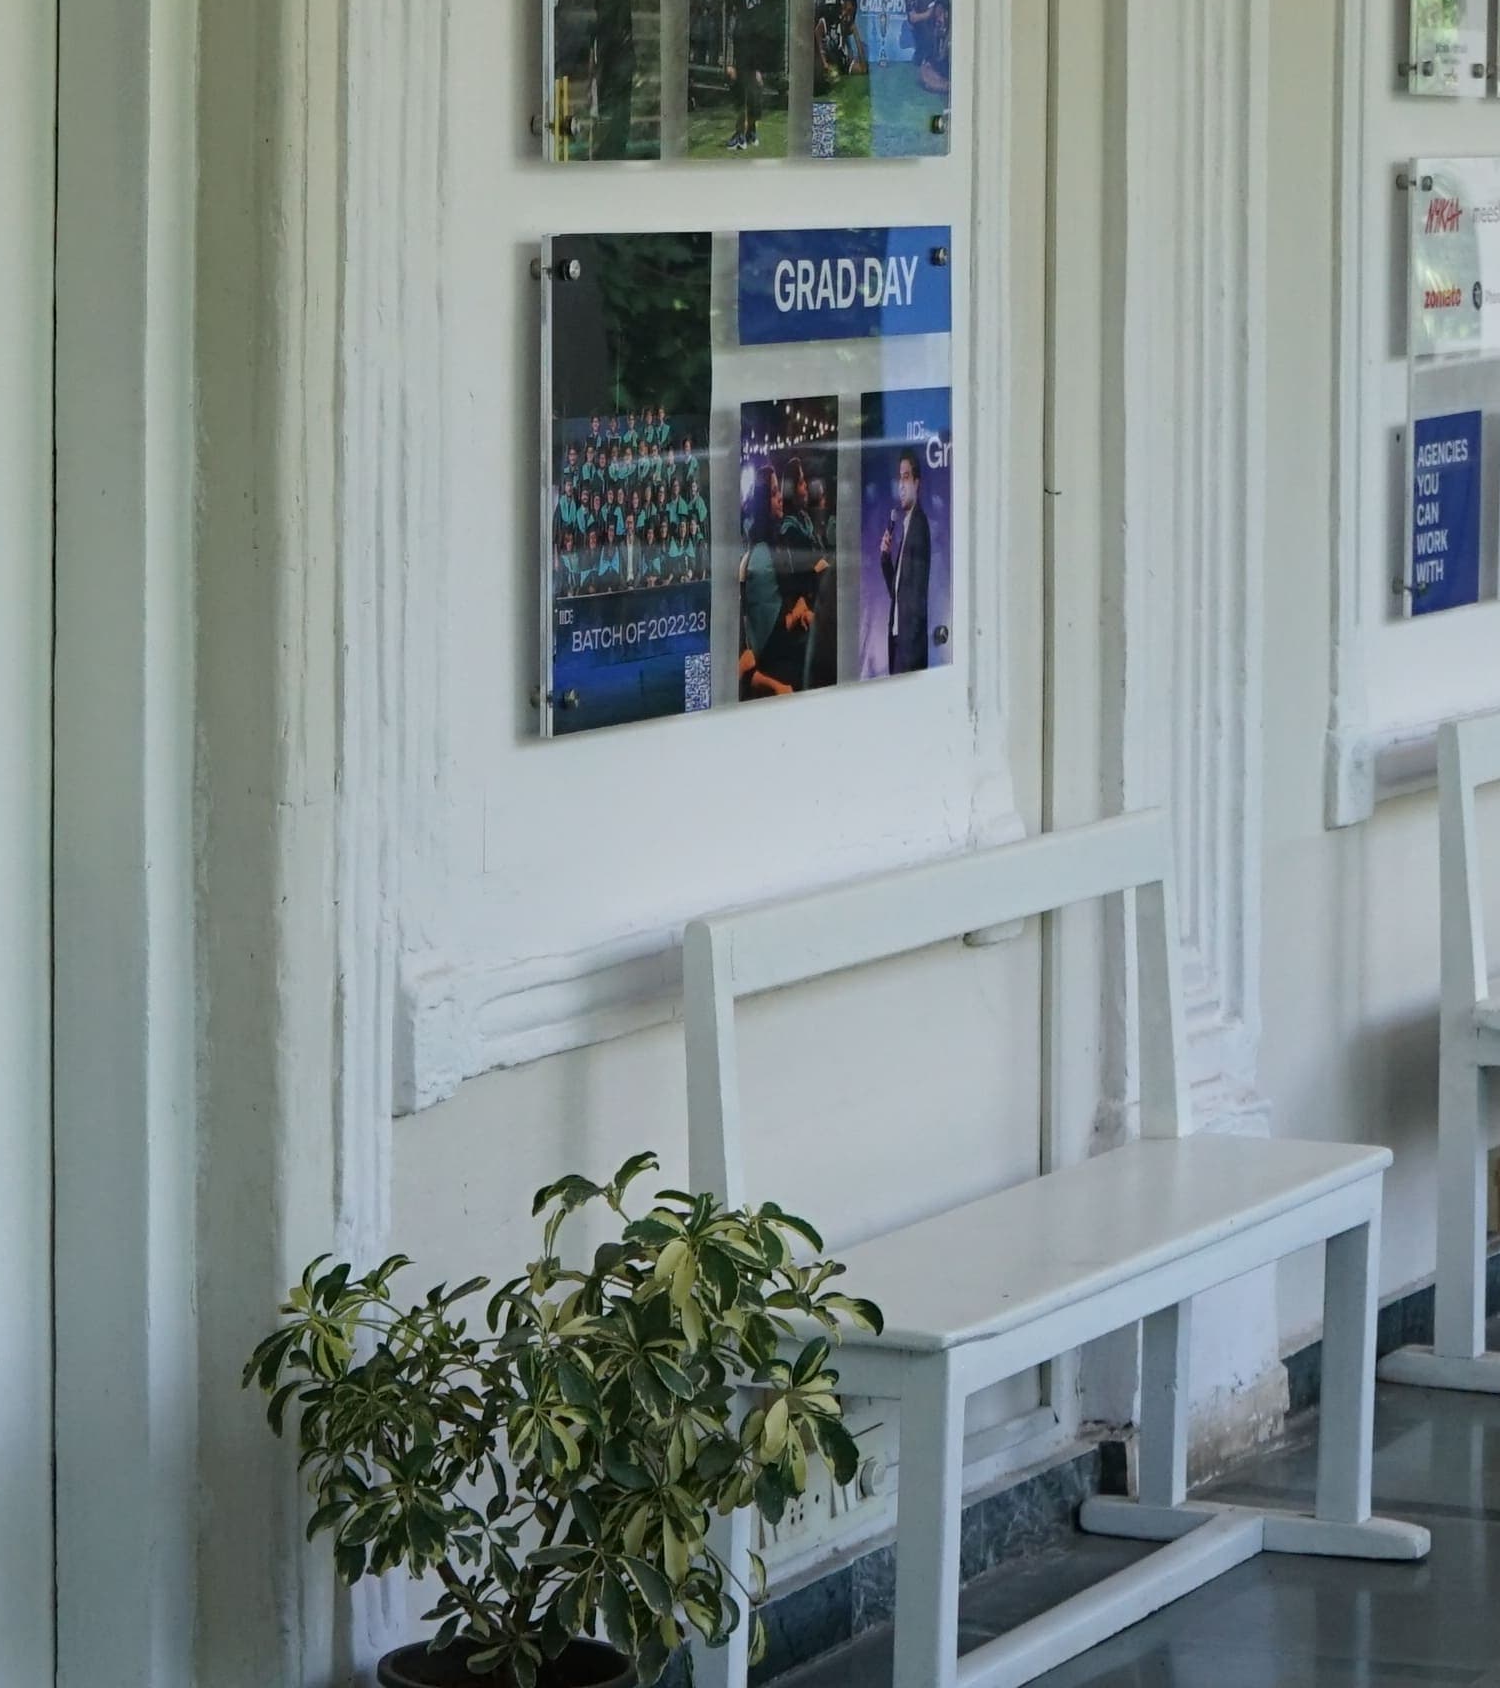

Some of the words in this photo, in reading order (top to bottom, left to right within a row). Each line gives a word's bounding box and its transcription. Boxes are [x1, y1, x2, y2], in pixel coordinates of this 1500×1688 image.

[774, 258, 858, 312] GRAD
[864, 255, 919, 308] DAY
[1416, 438, 1469, 468] AGENCIES
[1417, 472, 1440, 497] YOU
[1416, 502, 1440, 526] CAN
[1416, 529, 1449, 556] WORK
[1416, 560, 1444, 585] WITH
[572, 623, 623, 653] BATCH
[625, 621, 646, 644] OF
[648, 610, 707, 641] 2022-23
